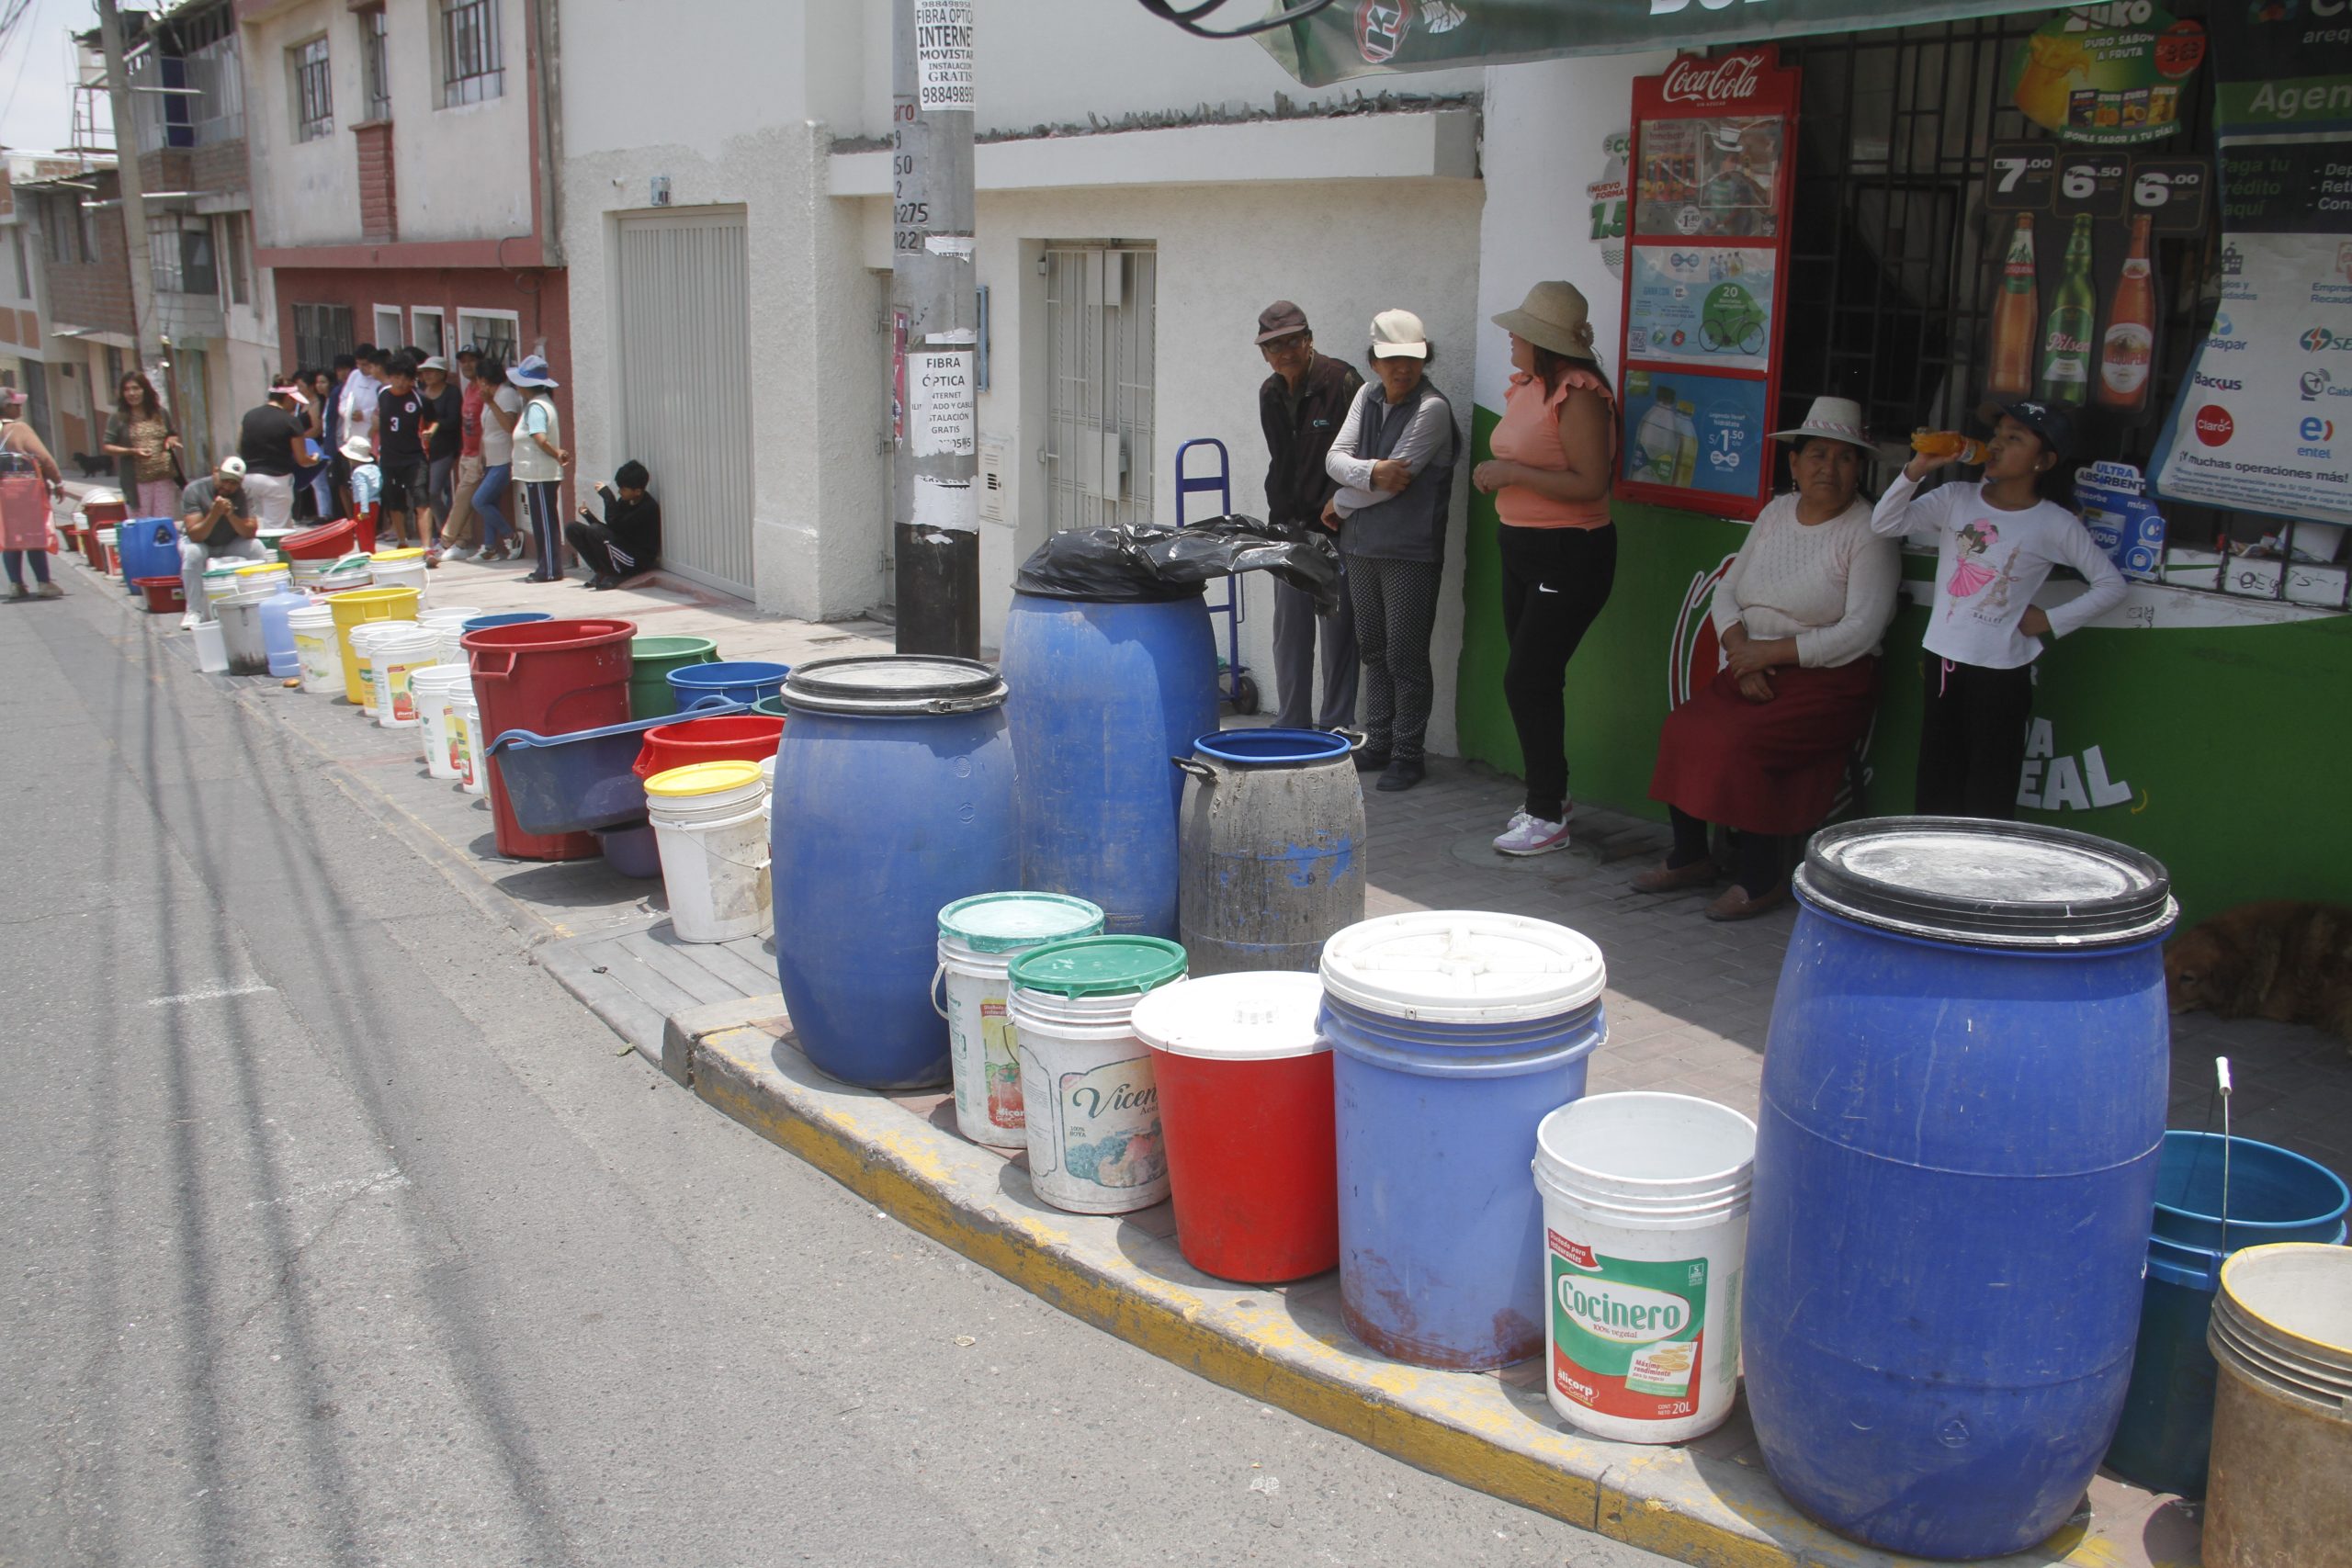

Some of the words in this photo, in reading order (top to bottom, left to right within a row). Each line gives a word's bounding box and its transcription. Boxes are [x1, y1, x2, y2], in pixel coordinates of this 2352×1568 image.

[916, 9, 947, 24] FIBRA
[2302, 28, 2352, 44] areq
[2084, 37, 2114, 50] PURO
[2096, 51, 2107, 62] A
[2109, 46, 2144, 60] FRUTA
[928, 72, 973, 82] GRATIS
[2270, 158, 2291, 172] tu
[1590, 182, 1622, 194] NUEVO
[2318, 197, 2352, 210] Con
[1723, 287, 1738, 297] 20
[2045, 332, 2091, 354] Pilsen
[926, 358, 961, 368] FIBRA
[390, 416, 400, 432] 3
[931, 425, 960, 434] GRATIS
[2197, 418, 2231, 432] Claro
[2298, 446, 2333, 459] entel
[2096, 463, 2133, 478] ULTRA
[2188, 455, 2233, 469] muchas
[2234, 462, 2313, 479] operaciones
[2316, 471, 2349, 484] más!
[1072, 1083, 1157, 1119] Vicen
[1562, 1280, 1681, 1332] Cocinero
[1611, 1329, 1638, 1339] vegetal
[1633, 1366, 1671, 1377] rendimiento
[1634, 1359, 1661, 1371] Máximo
[1671, 1401, 1691, 1415] 20L
